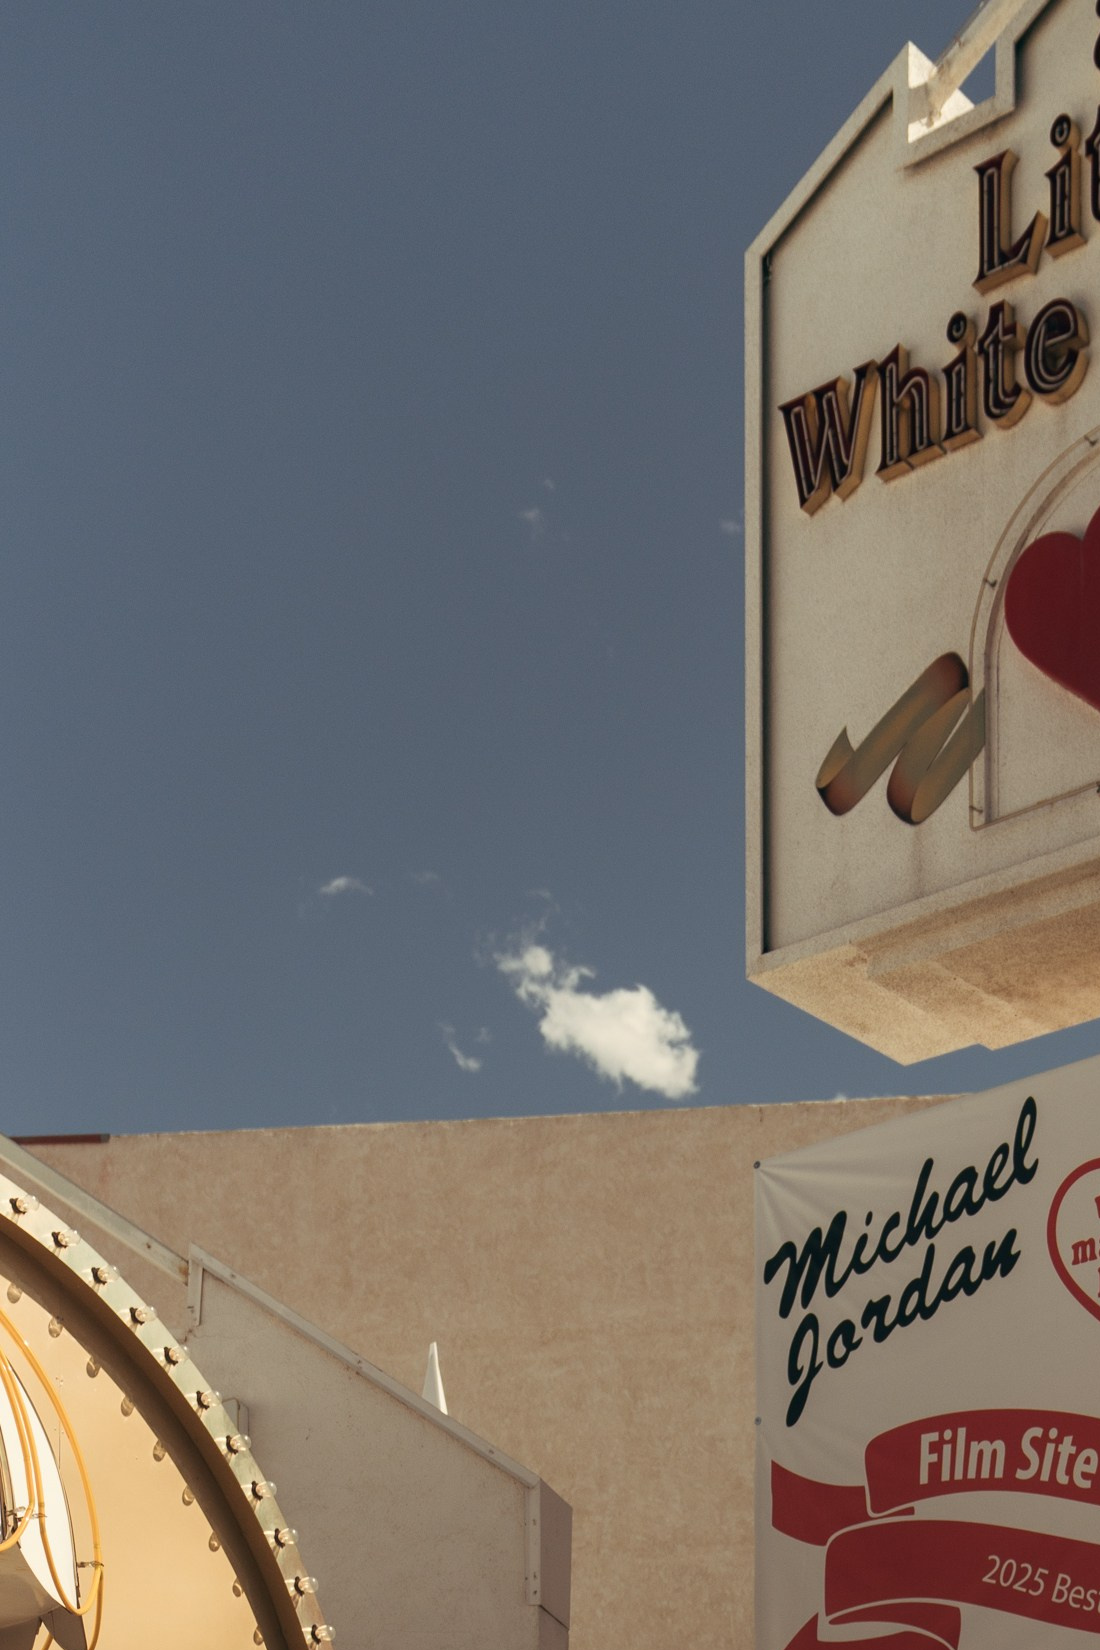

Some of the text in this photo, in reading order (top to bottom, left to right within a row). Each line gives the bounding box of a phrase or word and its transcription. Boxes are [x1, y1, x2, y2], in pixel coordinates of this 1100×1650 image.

[778, 297, 1090, 516] White
[763, 1096, 1039, 1320] Michael
[785, 1227, 1021, 1427] Jordan
[918, 1427, 1005, 1486] Film
[1014, 1425, 1096, 1490] Site
[981, 1554, 1050, 1597] 2025
